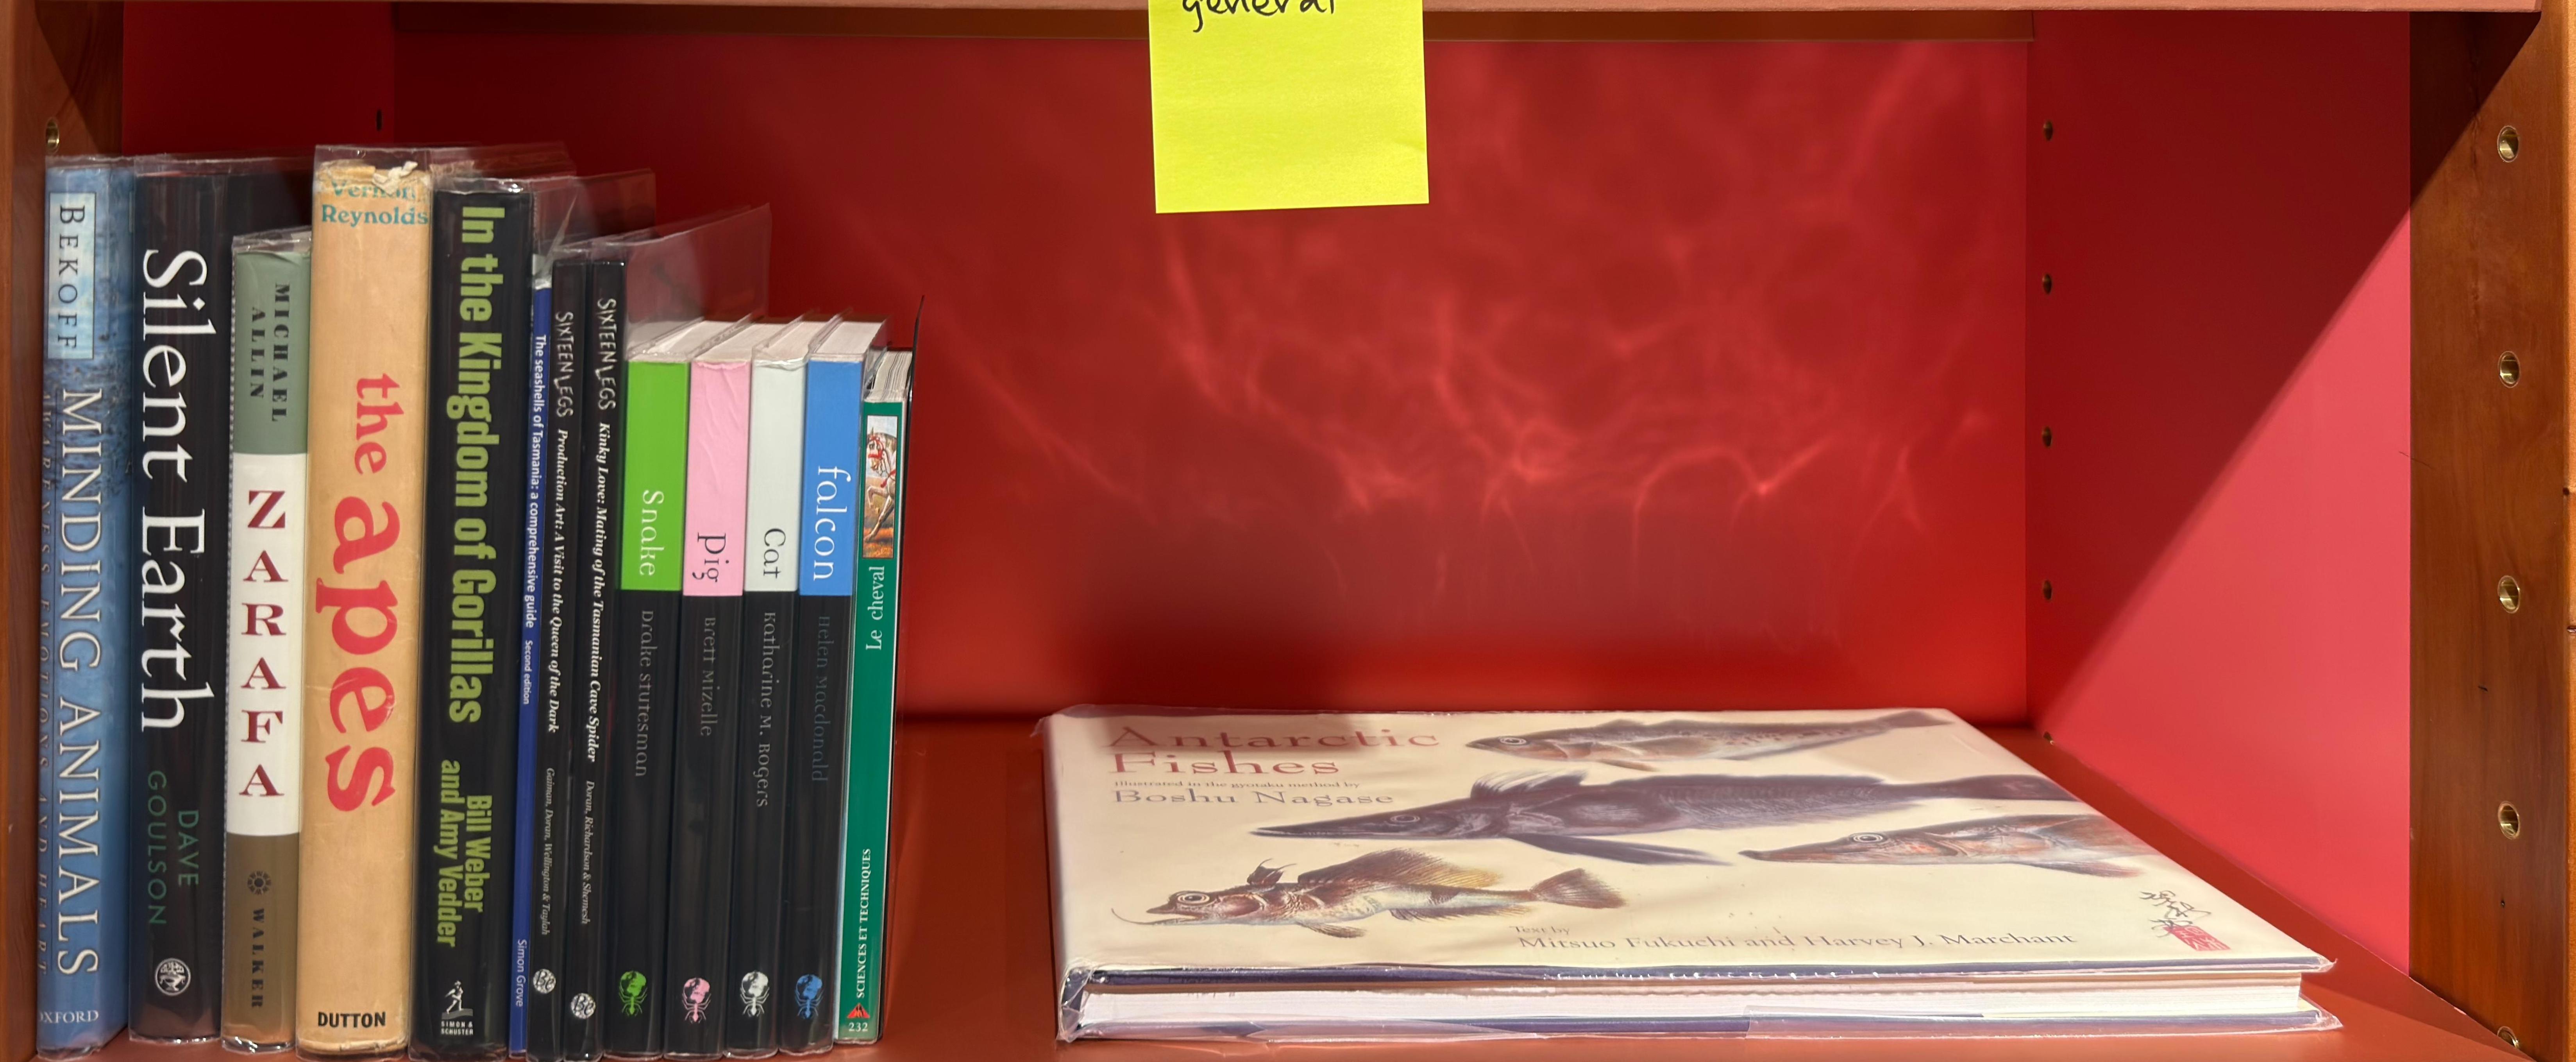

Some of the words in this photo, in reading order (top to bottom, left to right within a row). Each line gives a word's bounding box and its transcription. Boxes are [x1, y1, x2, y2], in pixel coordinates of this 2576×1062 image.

[322, 204, 428, 227] Reynolds
[462, 206, 505, 243] In
[57, 205, 85, 349] BEKOFF
[459, 254, 504, 321] the
[143, 249, 216, 483] Silent
[250, 306, 266, 399] ALLIN
[272, 283, 291, 422] MICHAEL
[535, 335, 547, 356] The
[533, 359, 546, 412] seashells
[354, 373, 404, 475] the
[447, 332, 502, 507] Kingdom
[533, 415, 544, 429] of
[597, 422, 610, 462] Kinky
[531, 430, 543, 490] Tasmania:
[556, 429, 568, 501] Production
[597, 466, 609, 504] Love:
[59, 388, 102, 672] MINDING
[454, 518, 497, 559] of
[554, 532, 565, 542] A
[555, 503, 565, 530] Art:
[593, 507, 607, 556] Mating
[638, 489, 665, 577] Snake
[813, 465, 851, 582] falcon
[526, 502, 540, 592] comprehensive
[553, 546, 565, 574] Visit
[592, 559, 606, 575] of
[692, 531, 729, 583] Pig
[762, 527, 786, 578] Cat
[552, 593, 563, 614] the
[553, 577, 563, 591] to
[593, 576, 605, 598] the
[867, 566, 885, 621] cheval
[141, 507, 215, 732] Earth
[524, 595, 537, 628] guide
[239, 491, 289, 796] ZARAFA
[315, 496, 400, 812] apes
[449, 569, 497, 723] Gorillas
[524, 640, 534, 672] Second
[549, 616, 562, 657] Queen
[590, 600, 604, 677] Tasmanian
[640, 610, 658, 667] Drake
[703, 617, 717, 663] Brett
[817, 615, 835, 668] Helen
[866, 629, 883, 651] Le
[548, 659, 560, 676] of
[759, 611, 780, 708] Katharine
[523, 673, 533, 704] edition
[550, 676, 561, 697] the
[589, 680, 602, 713] Cave
[700, 670, 720, 737] Mizelle
[549, 699, 560, 733] Dark
[586, 715, 601, 762] Spider
[759, 715, 772, 736] M.
[811, 675, 830, 782] Macdonald
[1107, 726, 1440, 748] Antarctic
[440, 759, 465, 803] and
[752, 743, 770, 808] Rogers
[1108, 749, 1340, 775] Fishes
[544, 768, 555, 807] Gaiman,
[584, 781, 595, 813] Doran,
[1112, 788, 1239, 803] Boshu
[1252, 791, 1394, 807] Nagase
[57, 697, 101, 974] ANIMALS
[433, 809, 465, 860] Amy
[465, 794, 493, 832] Bill
[543, 809, 554, 841] Doran,
[147, 770, 166, 924] GOULSON
[178, 810, 199, 886] DAVE
[583, 816, 593, 870] Richardson
[464, 836, 492, 913] Weber
[542, 843, 552, 892] Wellington
[583, 872, 591, 881] &
[859, 848, 871, 924] TECHNIQUES
[436, 863, 464, 947] Vedder
[540, 903, 550, 935] Taylah
[581, 882, 592, 924] Shemesh
[858, 926, 868, 941] ET
[1518, 937, 1616, 948] Mitsuo
[1625, 936, 1736, 949] Fukuchi
[1743, 934, 1797, 948] and
[1801, 936, 1903, 949] Harvey
[1910, 935, 1933, 947] J.
[1937, 932, 2078, 944] Marchant
[1550, 926, 1570, 935] by
[252, 908, 265, 1008] WALKER
[517, 939, 527, 972] Simon
[856, 943, 867, 999] SCIENCES
[515, 975, 526, 1007] Grove
[318, 1011, 386, 1029] DUTTON
[848, 1022, 869, 1032] 232
